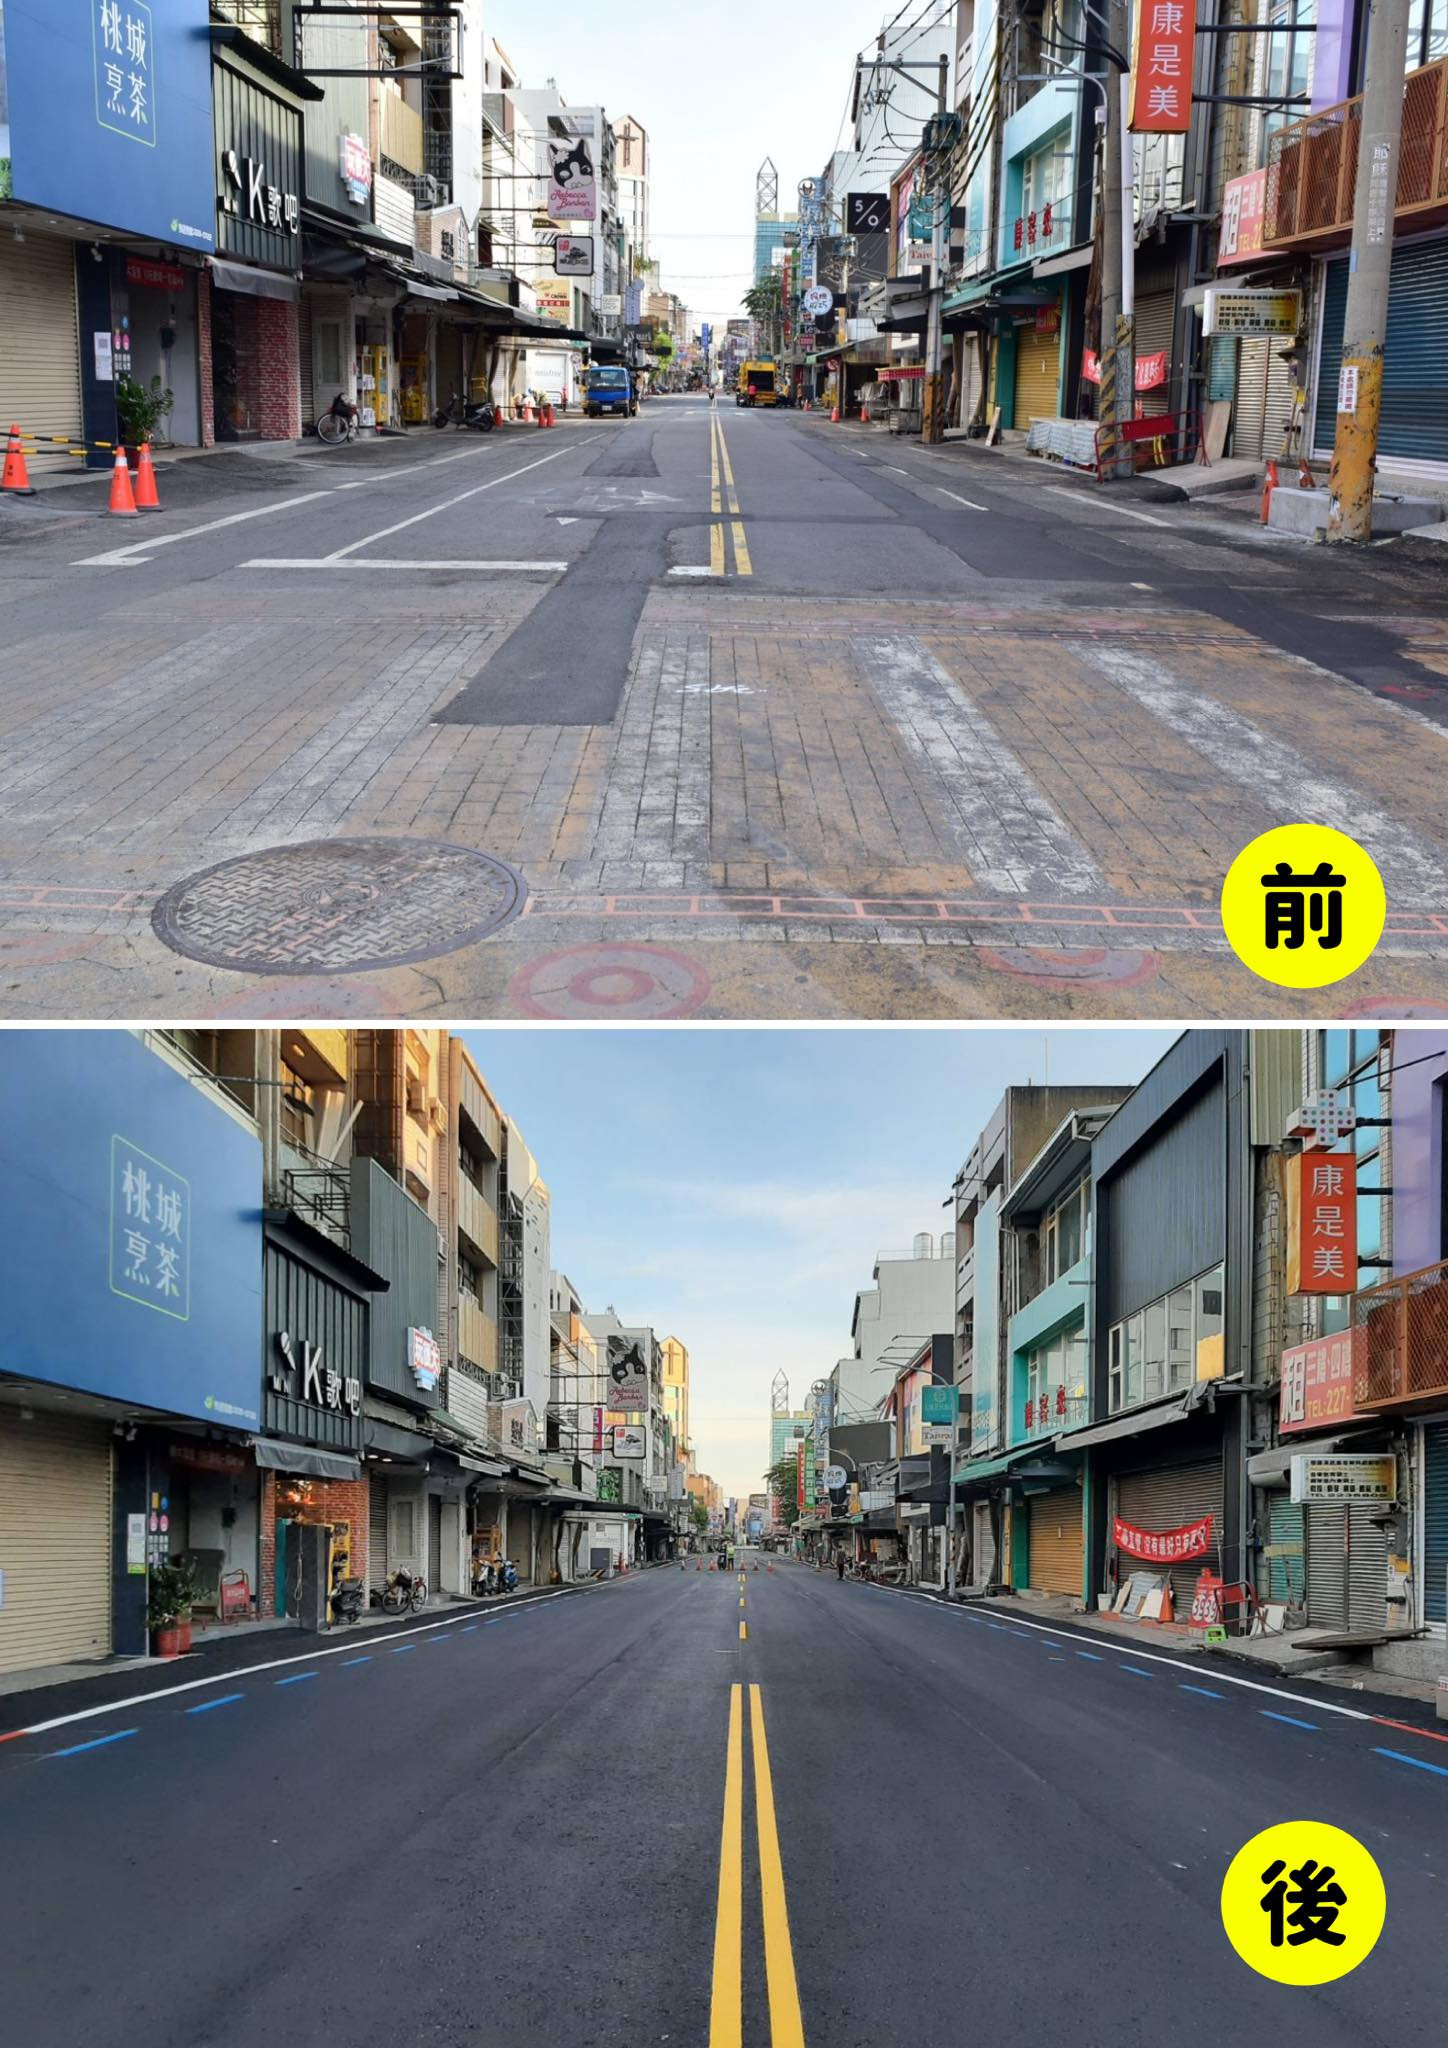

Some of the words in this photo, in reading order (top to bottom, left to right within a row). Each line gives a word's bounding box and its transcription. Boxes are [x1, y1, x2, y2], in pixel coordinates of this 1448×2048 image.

[100, 0, 147, 71] 桃城
[1147, 2, 1184, 118] 康是美
[104, 62, 148, 125] 烹茶
[122, 1161, 183, 1243] 桃城
[1312, 1164, 1345, 1279] 康是美
[123, 1228, 181, 1297] 烹茶
[304, 1340, 360, 1417] K歌吧
[1281, 1352, 1306, 1425] 租
